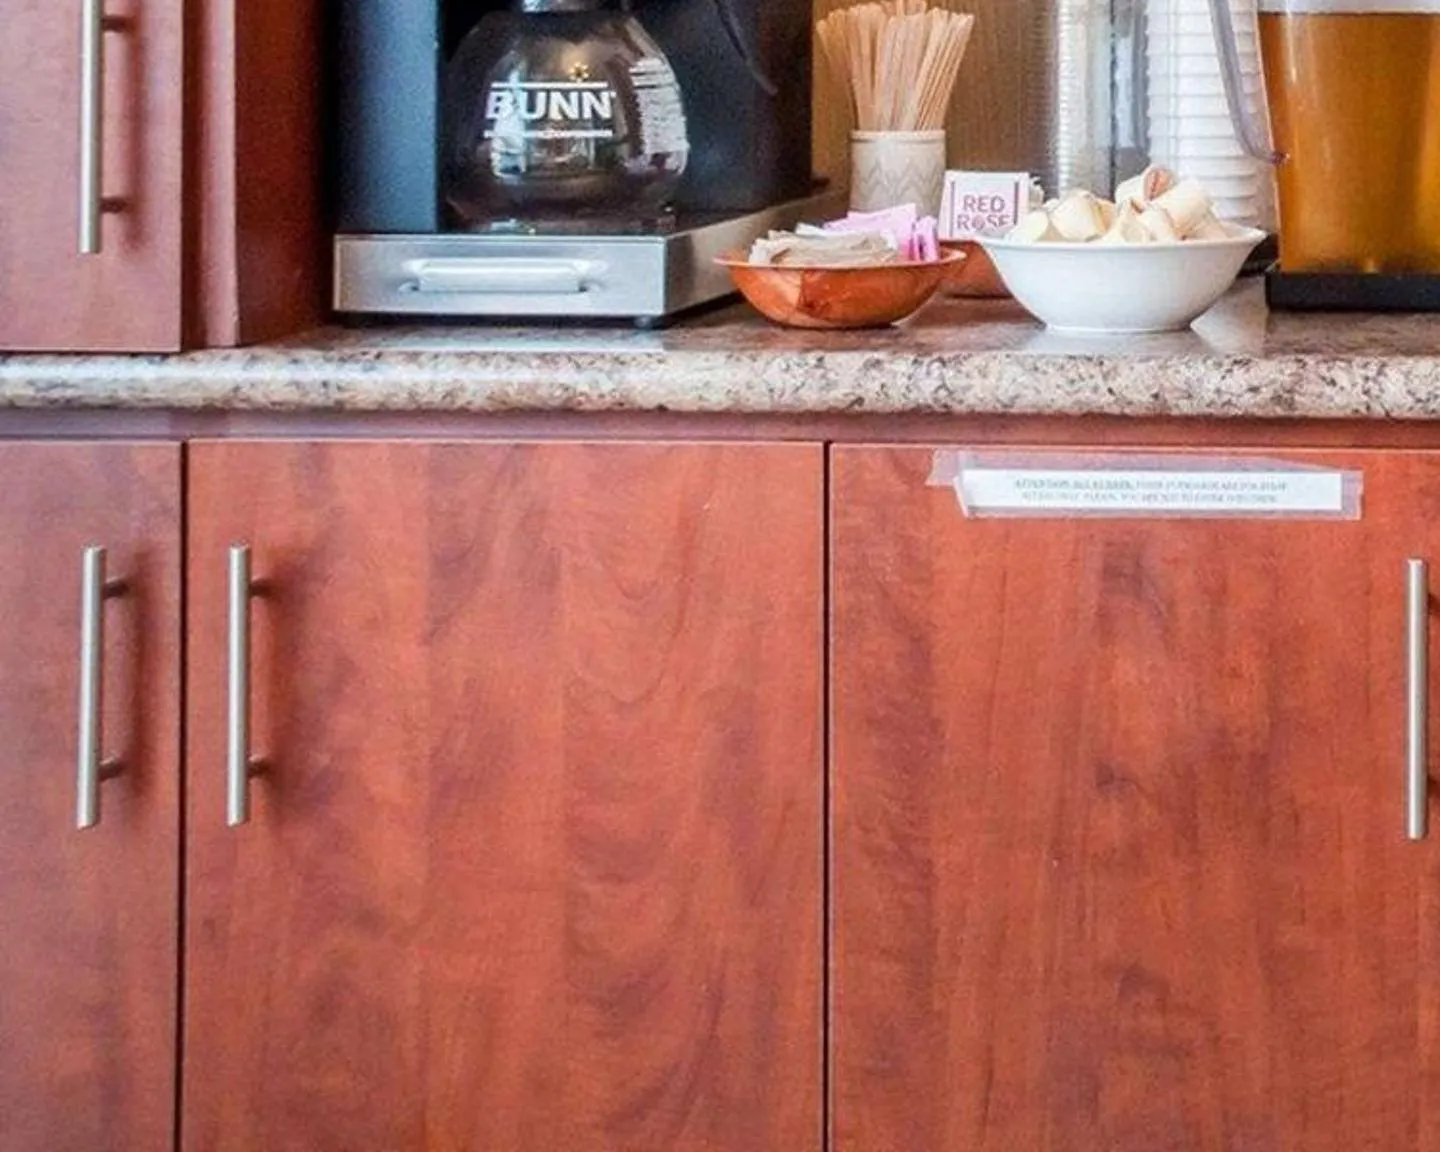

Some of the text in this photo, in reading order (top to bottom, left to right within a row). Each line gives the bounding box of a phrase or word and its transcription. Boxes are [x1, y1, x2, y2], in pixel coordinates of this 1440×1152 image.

[486, 90, 613, 120] BUNN
[963, 195, 1005, 213] RED
[957, 214, 1011, 231] ROSE
